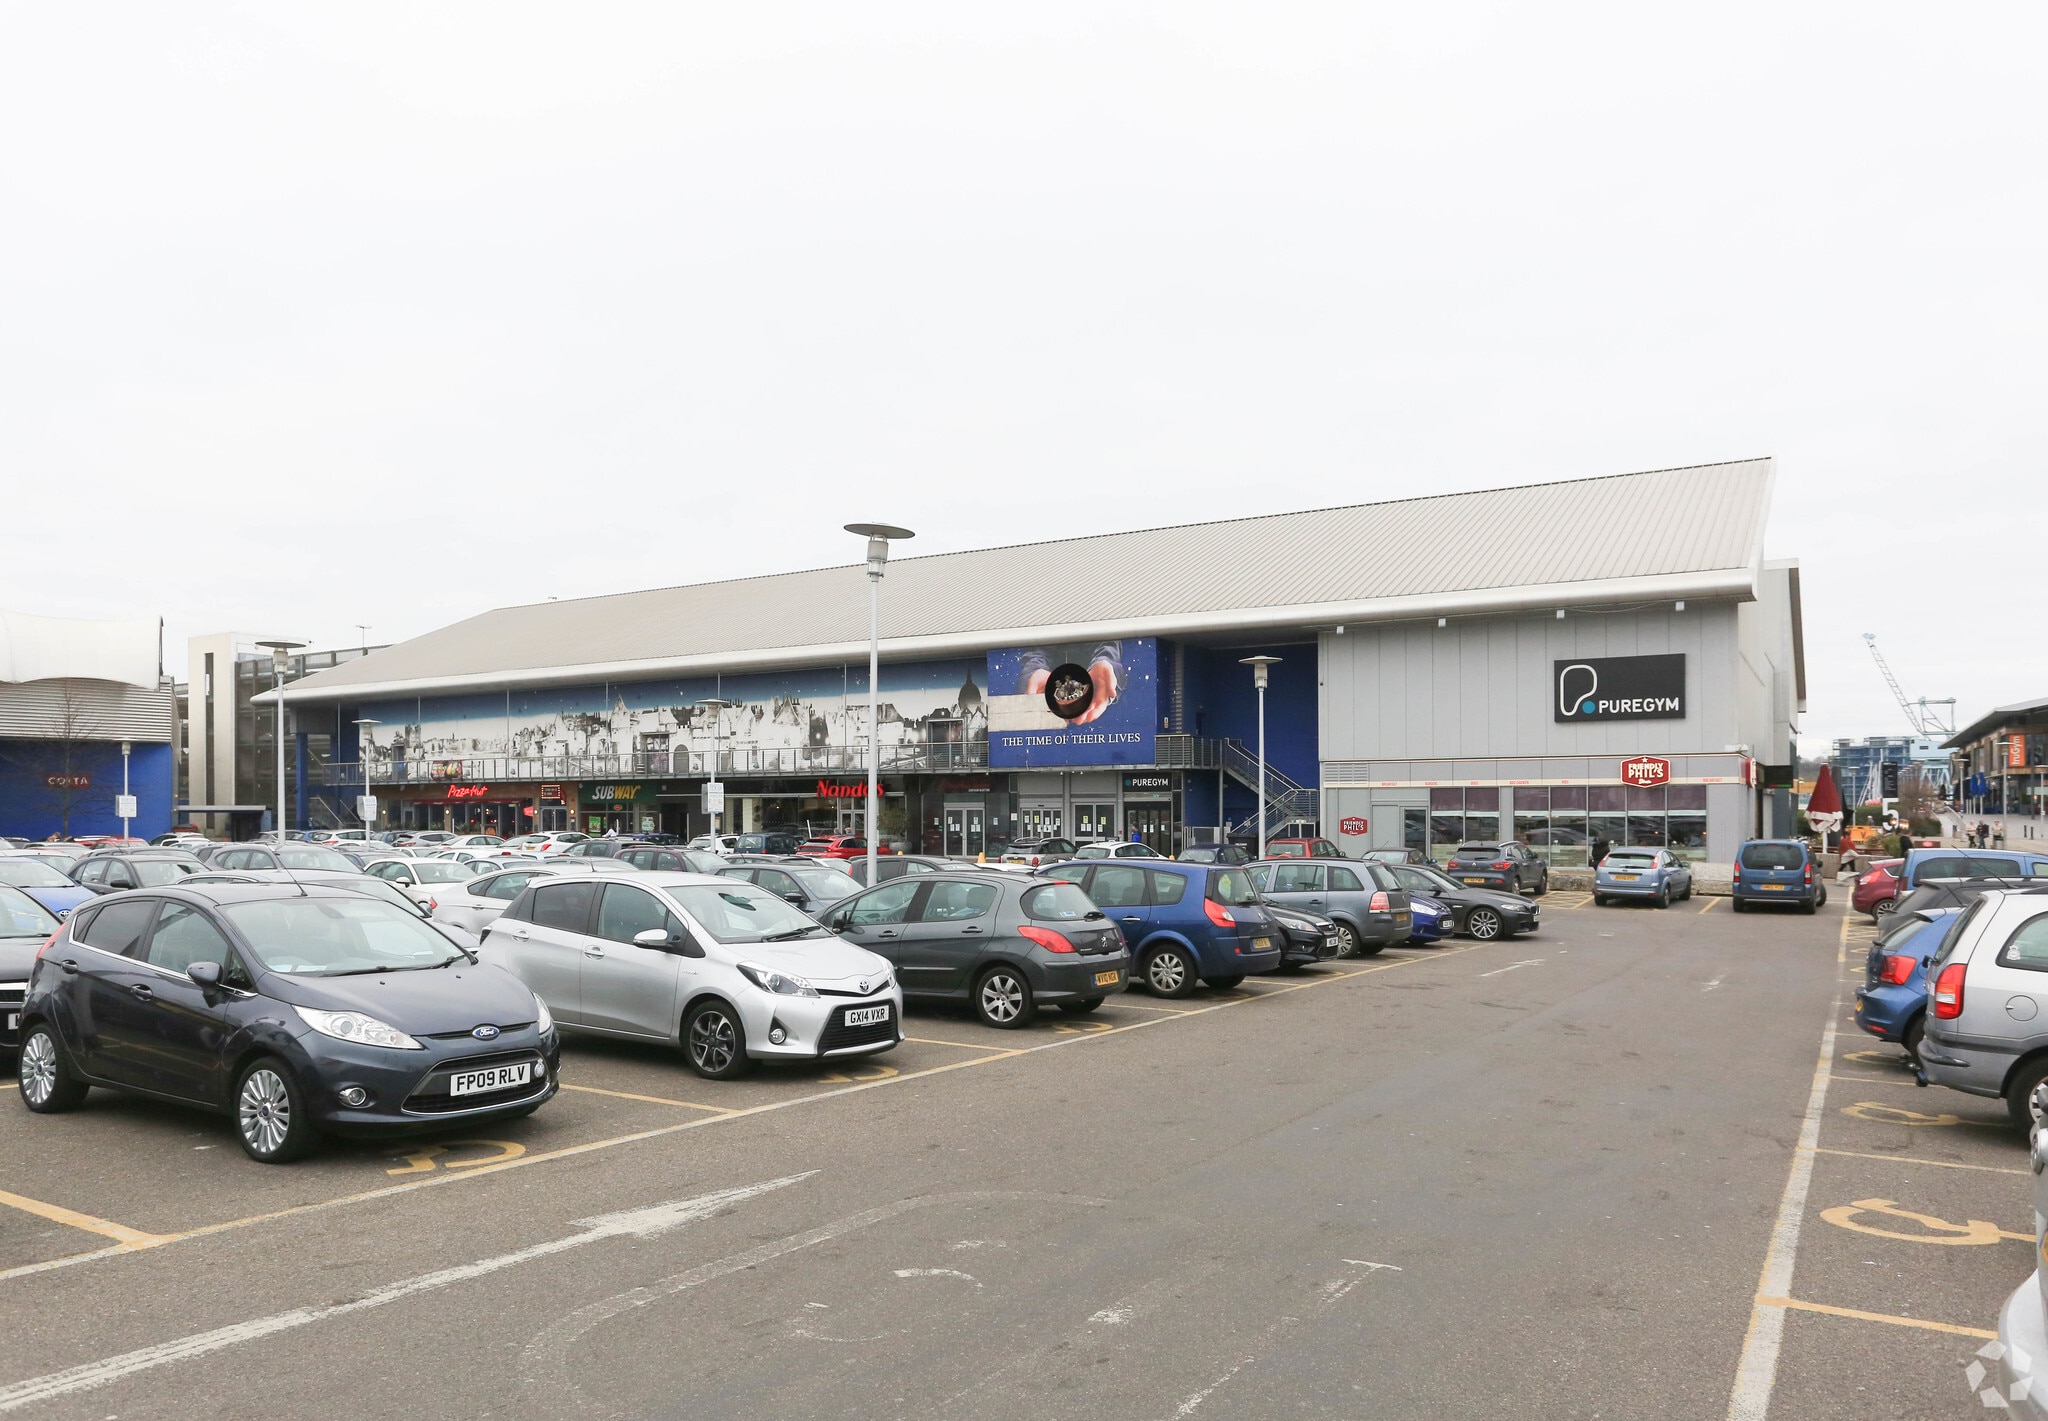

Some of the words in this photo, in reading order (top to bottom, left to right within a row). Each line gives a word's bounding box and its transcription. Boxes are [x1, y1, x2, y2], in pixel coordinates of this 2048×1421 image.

[1598, 697, 1680, 714] PUREGYM
[1001, 737, 1024, 747] THE
[1025, 735, 1052, 746] TIME
[1054, 734, 1069, 745] OF
[1071, 732, 1106, 744] THEIR
[1108, 732, 1141, 743] LIVES
[1628, 762, 1664, 771] FRIENDLY
[1628, 768, 1664, 779] PHIL'S
[1132, 778, 1169, 787] PUREGYM
[447, 785, 470, 798] Pizza
[469, 784, 488, 797] Hut
[591, 785, 642, 800] SUBWAY
[850, 1010, 869, 1024] GX14
[871, 1008, 885, 1021] VXR
[480, 1027, 495, 1037] Ford
[456, 1071, 496, 1092] FP09
[499, 1065, 525, 1085] RLV
